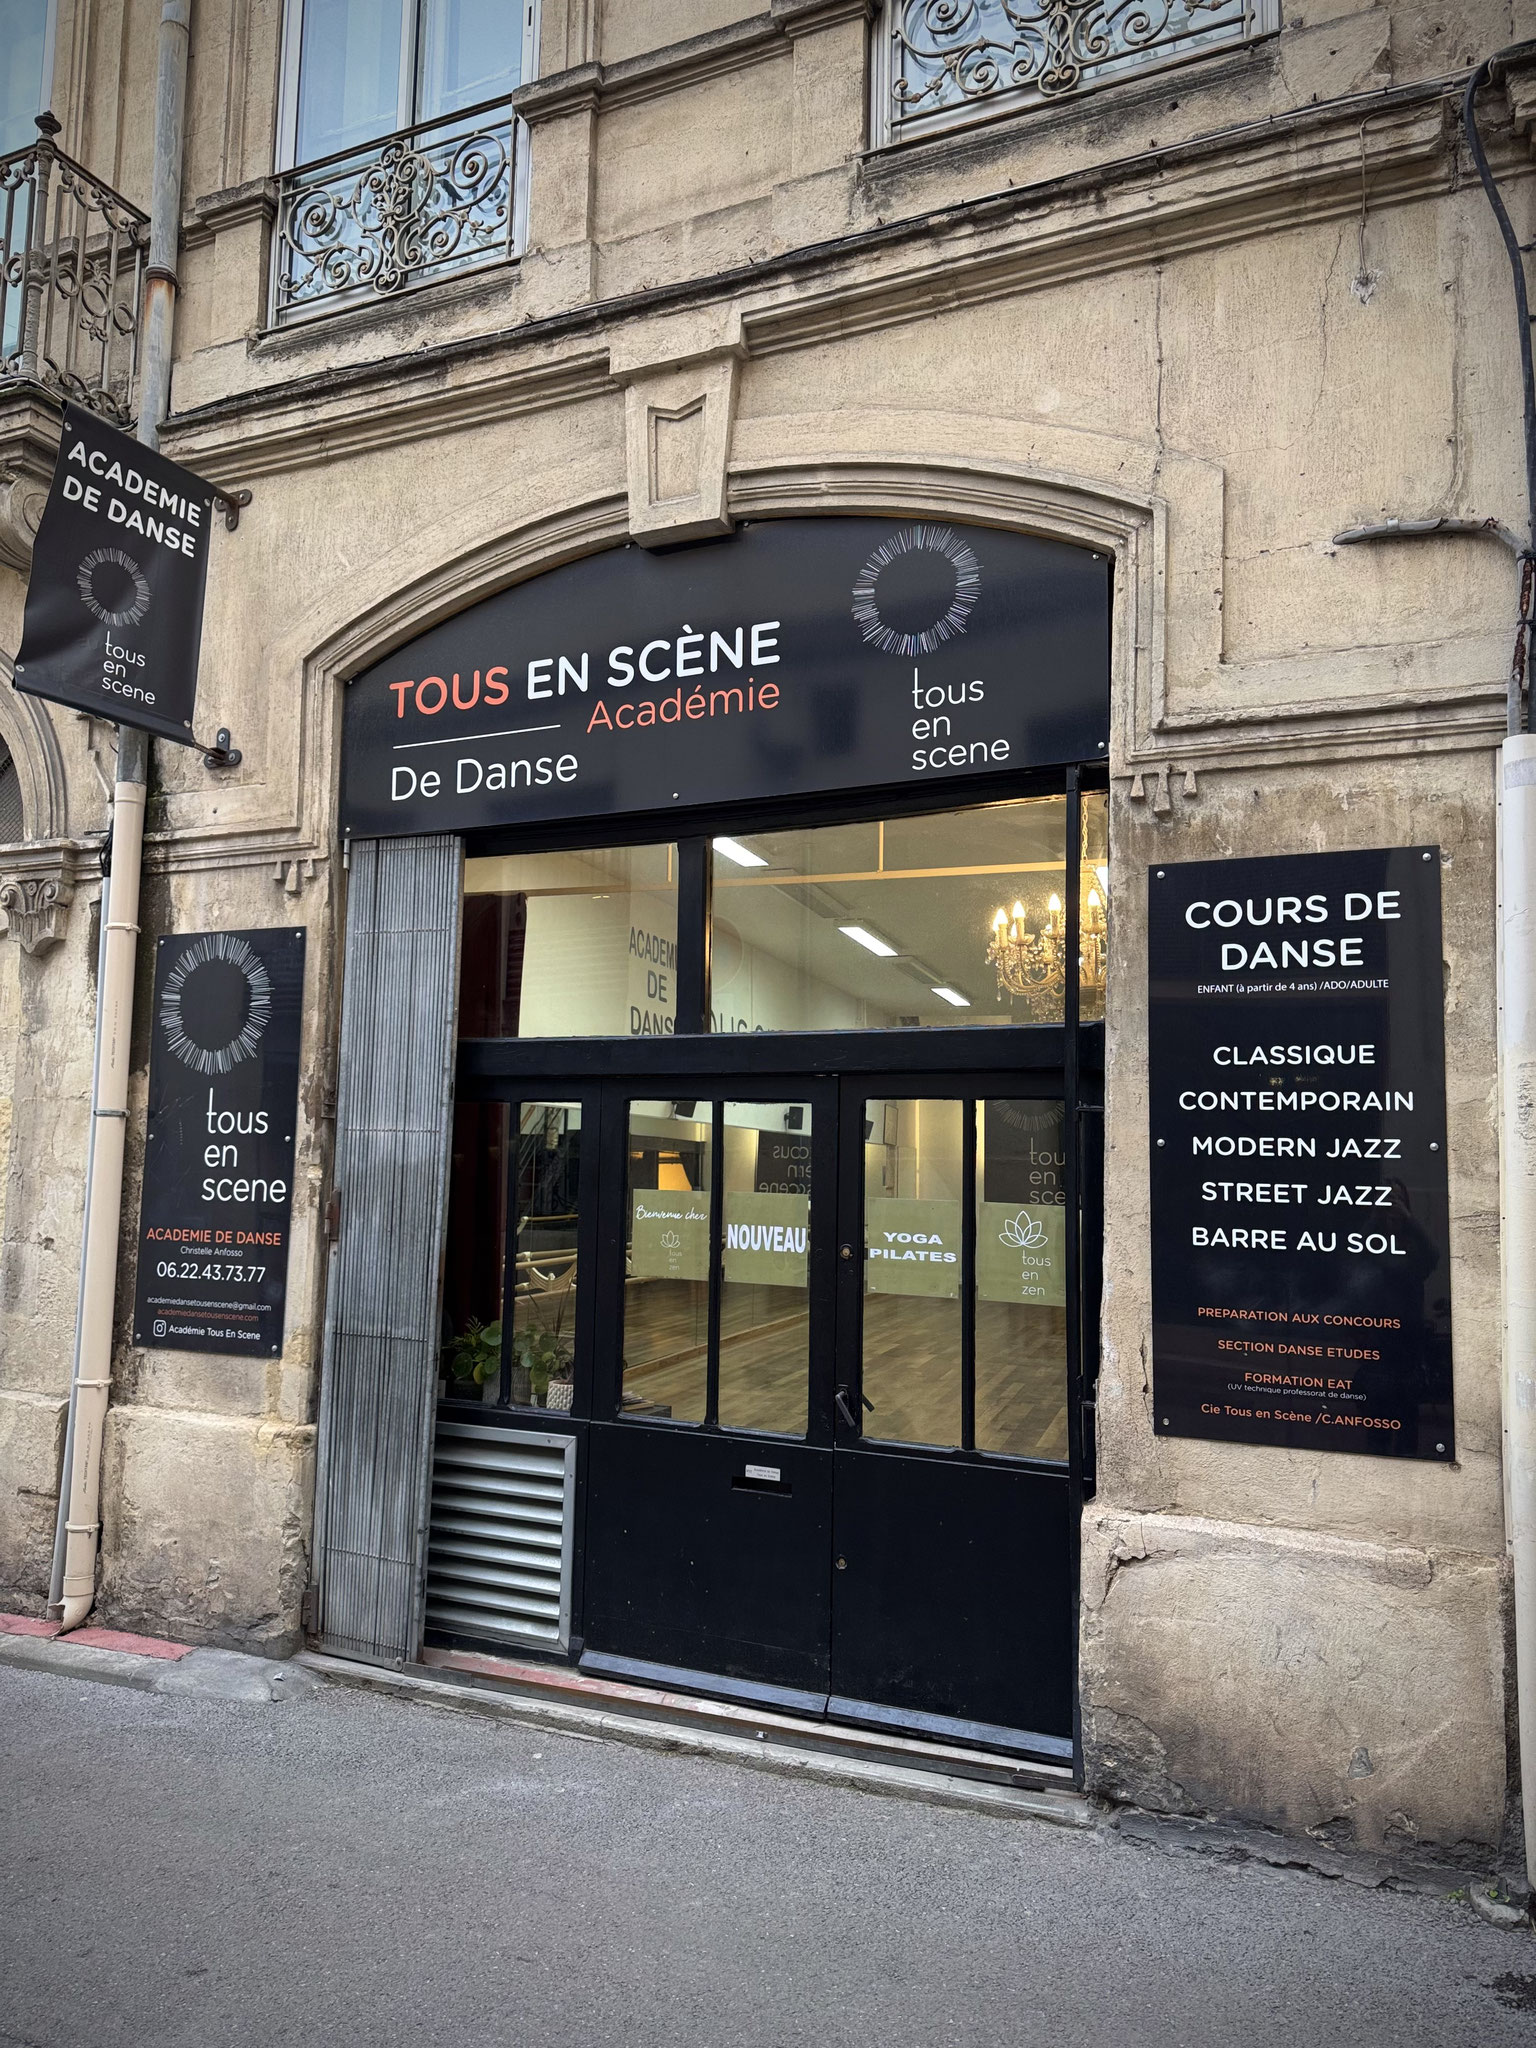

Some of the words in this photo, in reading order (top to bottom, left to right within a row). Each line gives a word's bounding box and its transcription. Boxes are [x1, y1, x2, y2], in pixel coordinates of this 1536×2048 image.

[67, 441, 201, 527] ACADEMIE
[62, 475, 103, 513] DE
[107, 498, 196, 558] DANSE
[105, 630, 146, 667] tous
[103, 660, 126, 678] en
[389, 665, 510, 719] TOUS
[527, 652, 589, 700] EN
[608, 620, 781, 689] SCÈNE
[102, 675, 155, 705] scene
[912, 666, 985, 709] tous
[586, 677, 780, 733] Académie
[912, 712, 951, 740] en
[912, 734, 1010, 771] scene
[391, 764, 441, 801] De
[456, 752, 579, 794] Danse
[1185, 894, 1328, 929] COURS
[1344, 890, 1402, 920] DE
[1221, 937, 1364, 971] DANSE
[648, 969, 667, 1002] DE
[1197, 984, 1234, 995] ENFANT
[1236, 984, 1245, 994] (à
[1247, 983, 1273, 994] partir
[1275, 982, 1287, 992] de
[1289, 982, 1295, 991] 4
[1297, 982, 1317, 992] ans)
[1319, 979, 1389, 990] /ADO/ADULTE
[631, 1005, 676, 1035] DANS
[1213, 1044, 1375, 1067] CLASSIQUE
[206, 1088, 268, 1134] tous
[1178, 1091, 1414, 1112] CONTEMPORAIN
[204, 1143, 237, 1168] en
[1029, 1137, 1065, 1166] tou
[1192, 1136, 1316, 1158] MODERN
[1326, 1138, 1402, 1160] JAZZ
[201, 1178, 286, 1203] scene
[1029, 1171, 1056, 1185] en
[1201, 1182, 1307, 1204] STREET
[1317, 1185, 1393, 1207] JAZZ
[636, 1205, 683, 1220] Bienvenue
[685, 1207, 707, 1220] chez
[146, 1228, 211, 1242] ACADEMIE
[215, 1231, 233, 1243] DE
[237, 1232, 281, 1245] DANSE
[727, 1224, 806, 1253] NOUVEAU
[883, 1232, 943, 1245] YOGA
[1192, 1227, 1286, 1251] BARRE
[1297, 1231, 1336, 1253] AU
[1347, 1234, 1406, 1256] SOL
[180, 1246, 212, 1255] Christelle
[214, 1248, 243, 1257] Anfosso
[870, 1248, 957, 1263] PILATES
[1022, 1250, 1051, 1266] tous
[157, 1261, 265, 1282] 06.22.43.73.77
[1022, 1271, 1038, 1281] en
[1022, 1286, 1045, 1295] zen
[147, 1296, 271, 1311] academiedansetousenscene@gmail.com
[1198, 1307, 1288, 1322] PREPARATION
[1292, 1313, 1319, 1324] AUX
[1323, 1314, 1400, 1329] CONCOURS
[168, 1325, 205, 1336] Académie
[207, 1327, 224, 1337] Tous
[226, 1329, 236, 1338] En
[237, 1330, 260, 1340] Scene
[1217, 1340, 1274, 1353] SECTION
[1278, 1344, 1323, 1357] DANSE
[1327, 1348, 1380, 1361] ETUDES
[1227, 1383, 1243, 1392] (UV
[1244, 1384, 1281, 1395] technique
[1283, 1387, 1326, 1398] professorat
[1328, 1390, 1338, 1398] de
[1340, 1391, 1366, 1401] danse)
[1244, 1372, 1323, 1388] FORMATION
[1328, 1378, 1352, 1390] EAT
[1201, 1403, 1221, 1415] Cie
[1224, 1405, 1252, 1417] Tous
[1256, 1410, 1270, 1419] en
[1274, 1409, 1312, 1423] Scène
[1315, 1413, 1401, 1430] /C.ANFOSSO
